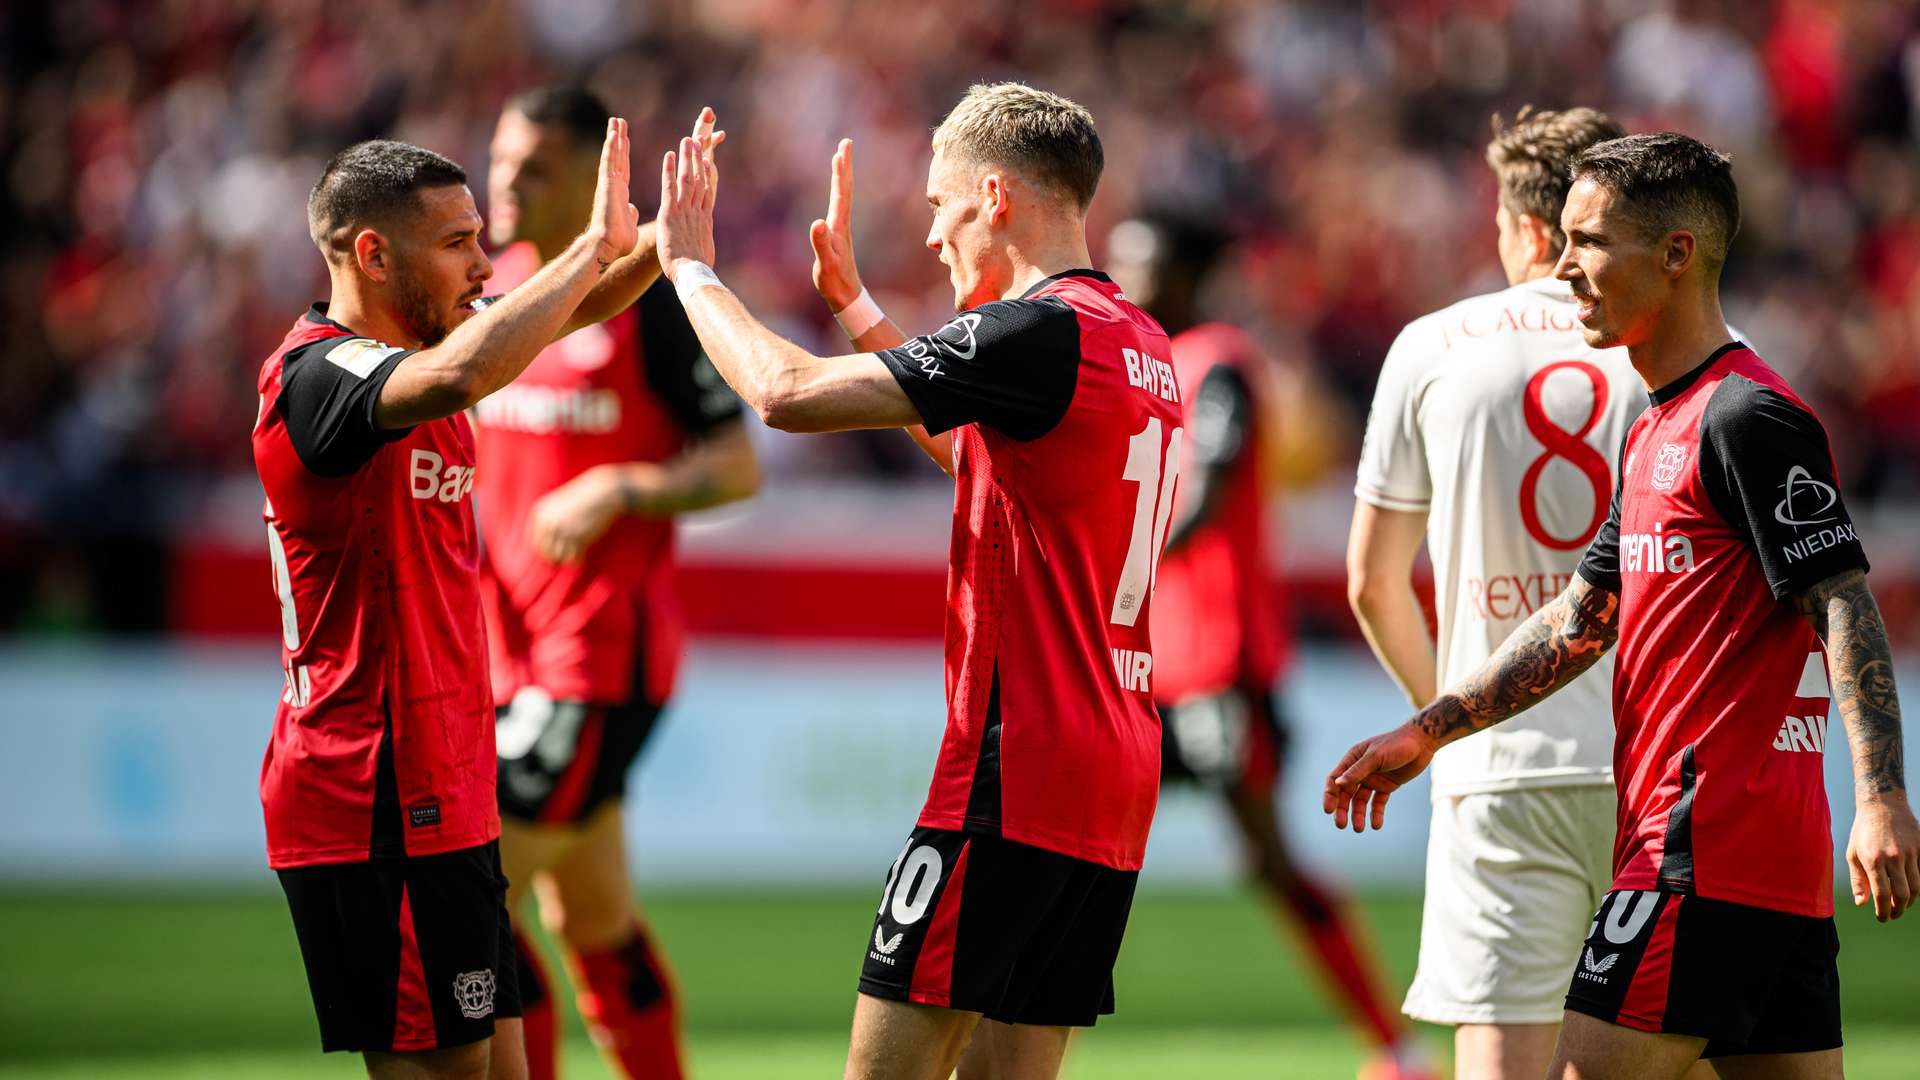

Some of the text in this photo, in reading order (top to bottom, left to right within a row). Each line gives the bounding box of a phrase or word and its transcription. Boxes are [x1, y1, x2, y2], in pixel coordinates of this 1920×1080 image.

[1496, 307, 1585, 333] AUG
[1121, 347, 1179, 403] BAYER
[1519, 360, 1611, 551] 8
[1782, 523, 1860, 564] NIEDAX
[877, 836, 943, 925] 10
[1588, 889, 1661, 944] 0
[1578, 971, 1608, 985] CASTORE
